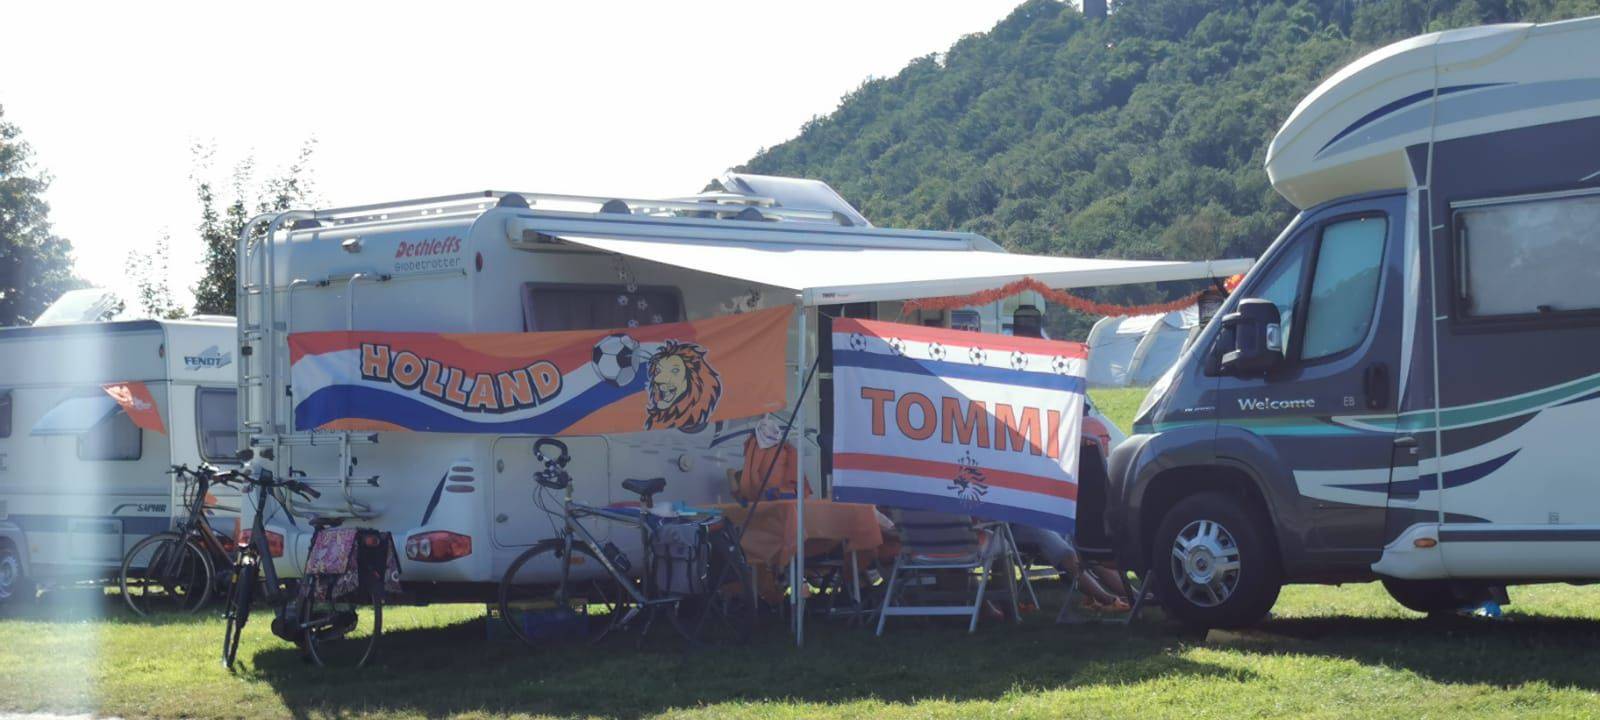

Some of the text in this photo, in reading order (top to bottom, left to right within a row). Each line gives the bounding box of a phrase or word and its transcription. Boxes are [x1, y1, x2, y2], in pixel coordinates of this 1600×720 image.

[395, 236, 462, 258] Dethleffs
[184, 356, 223, 366] FENDT
[359, 343, 564, 414] HOLLAND
[1238, 397, 1316, 410] Welcome
[861, 387, 1061, 458] TOMMI
